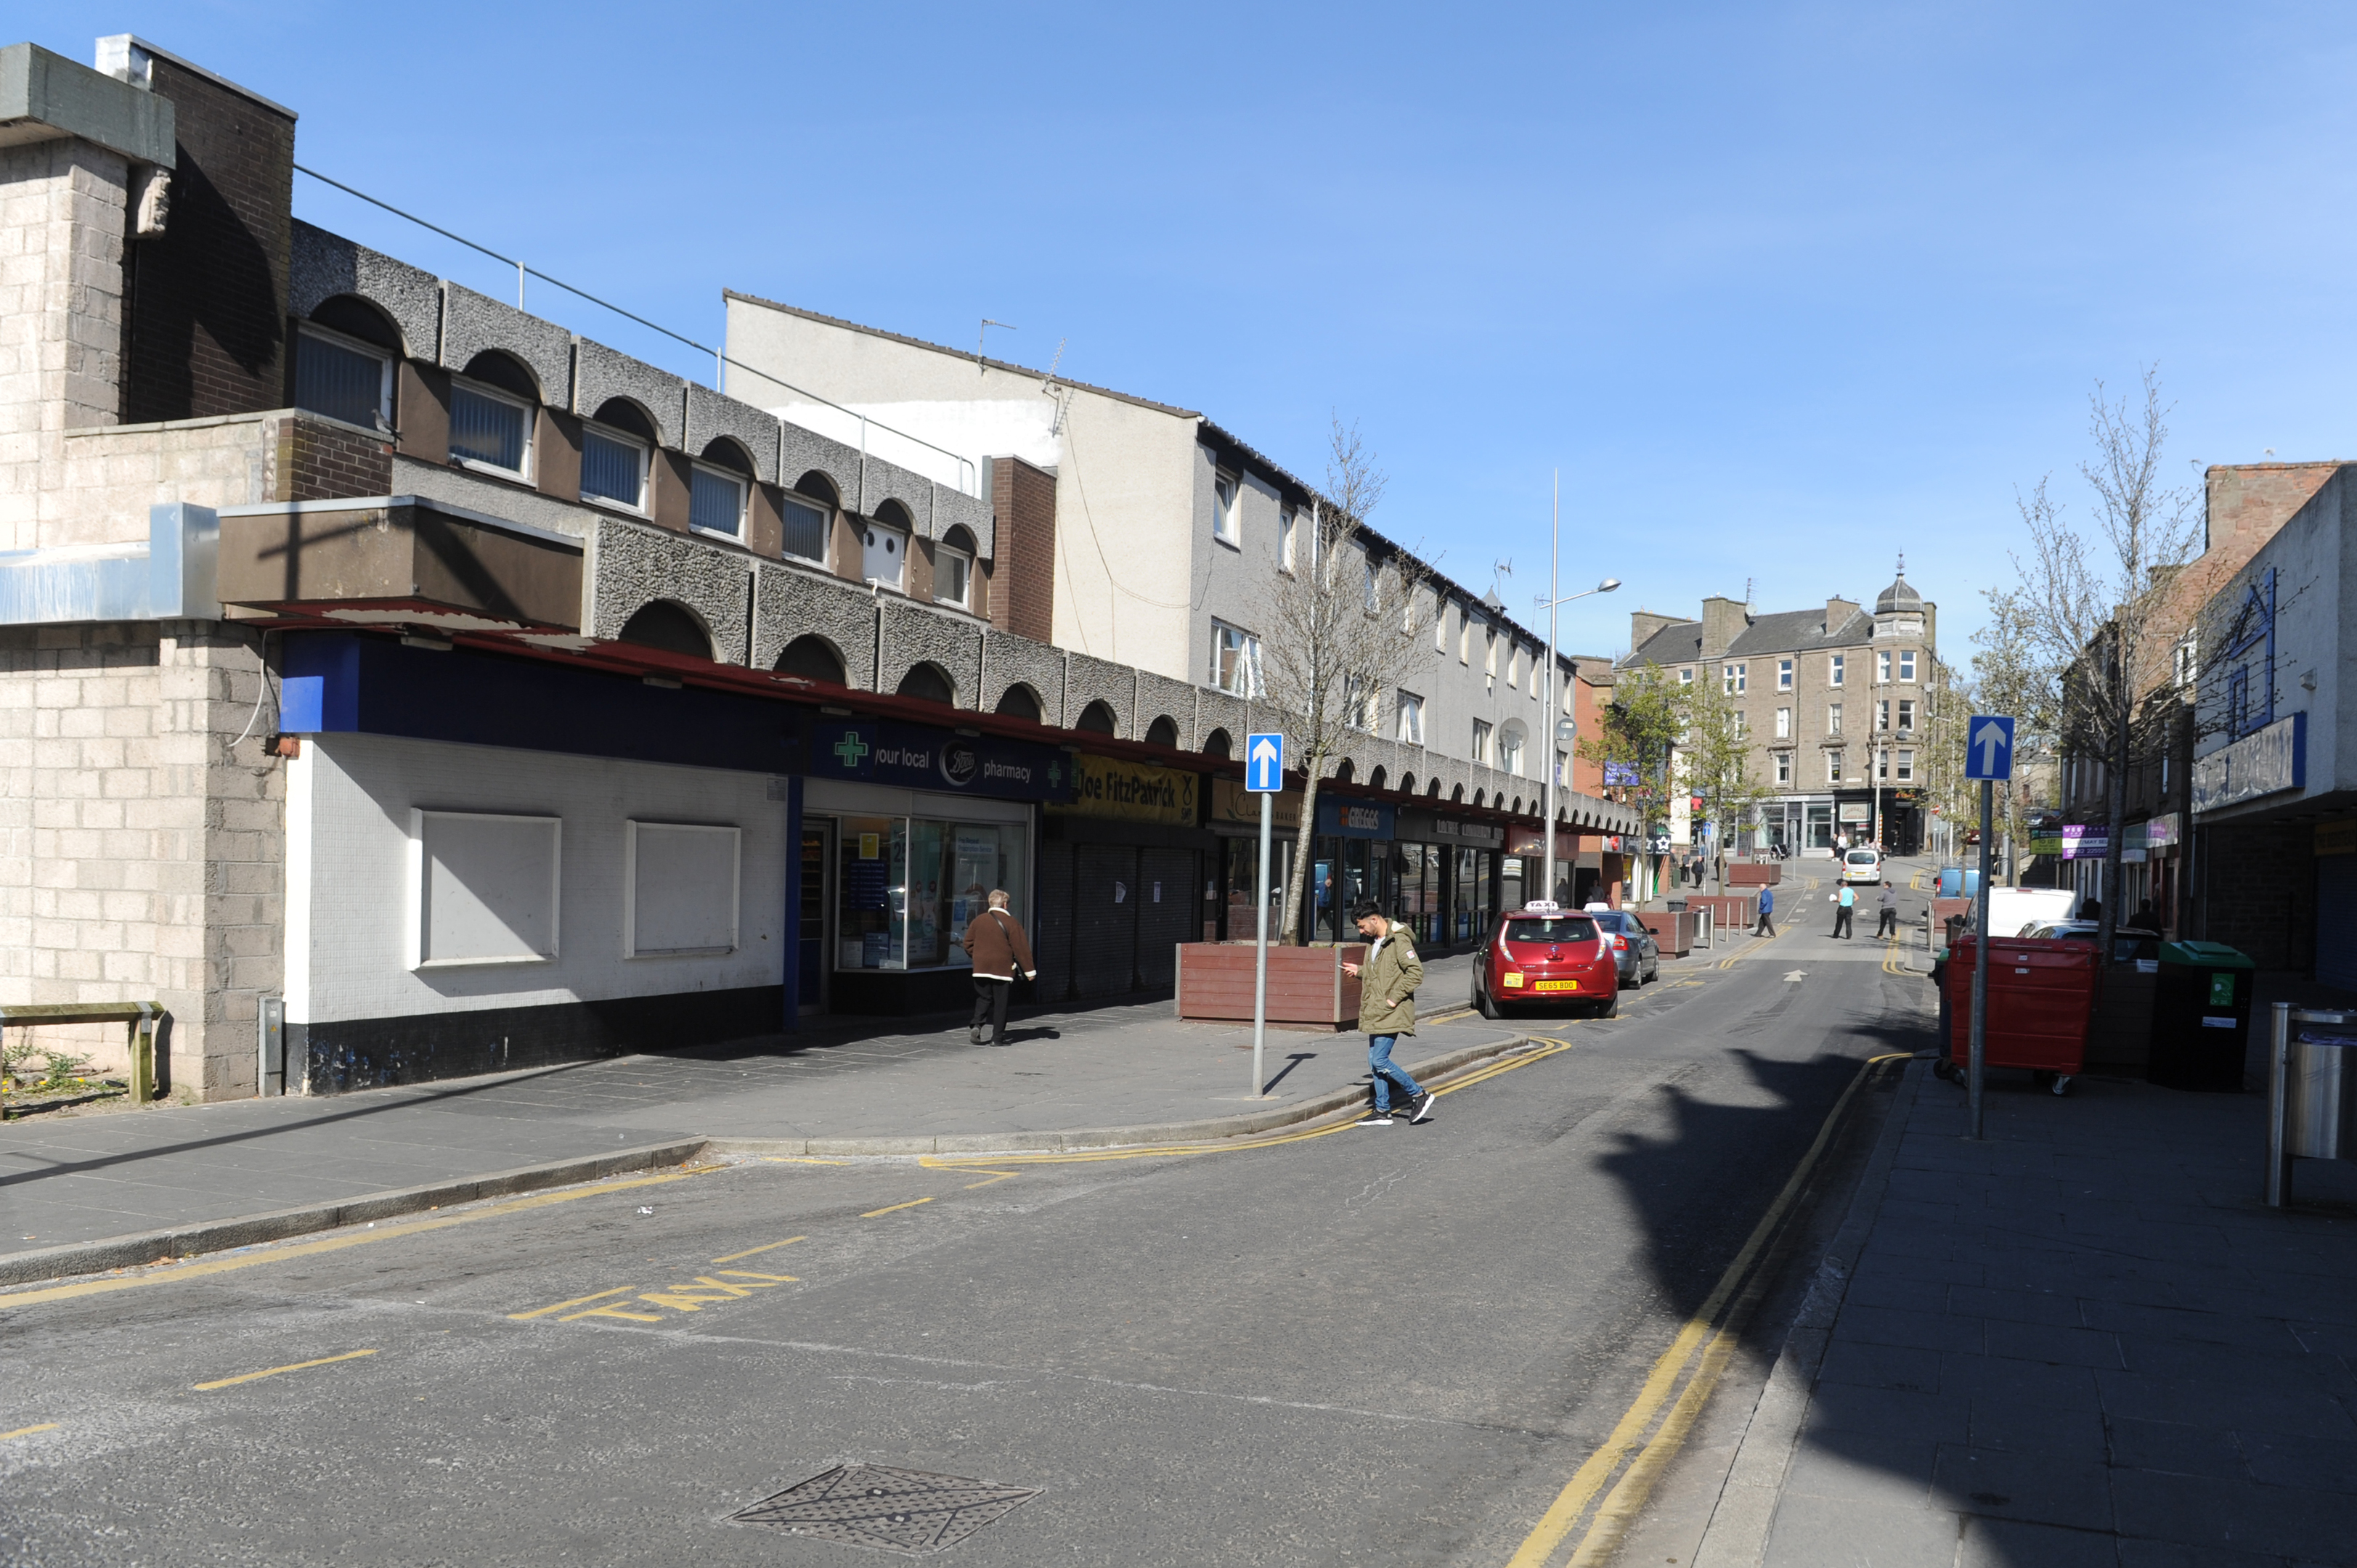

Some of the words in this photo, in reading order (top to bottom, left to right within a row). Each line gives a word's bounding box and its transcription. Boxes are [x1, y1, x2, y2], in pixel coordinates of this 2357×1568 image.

[902, 748, 929, 769] local
[949, 750, 977, 775] Boots
[984, 759, 1031, 784] pharmacy
[1078, 768, 1102, 800] Joe
[1107, 772, 1176, 809] FitzPatrick
[1181, 807, 1192, 820] SNP
[1348, 806, 1379, 830] GREGGS
[558, 1270, 799, 1322] TAXI
